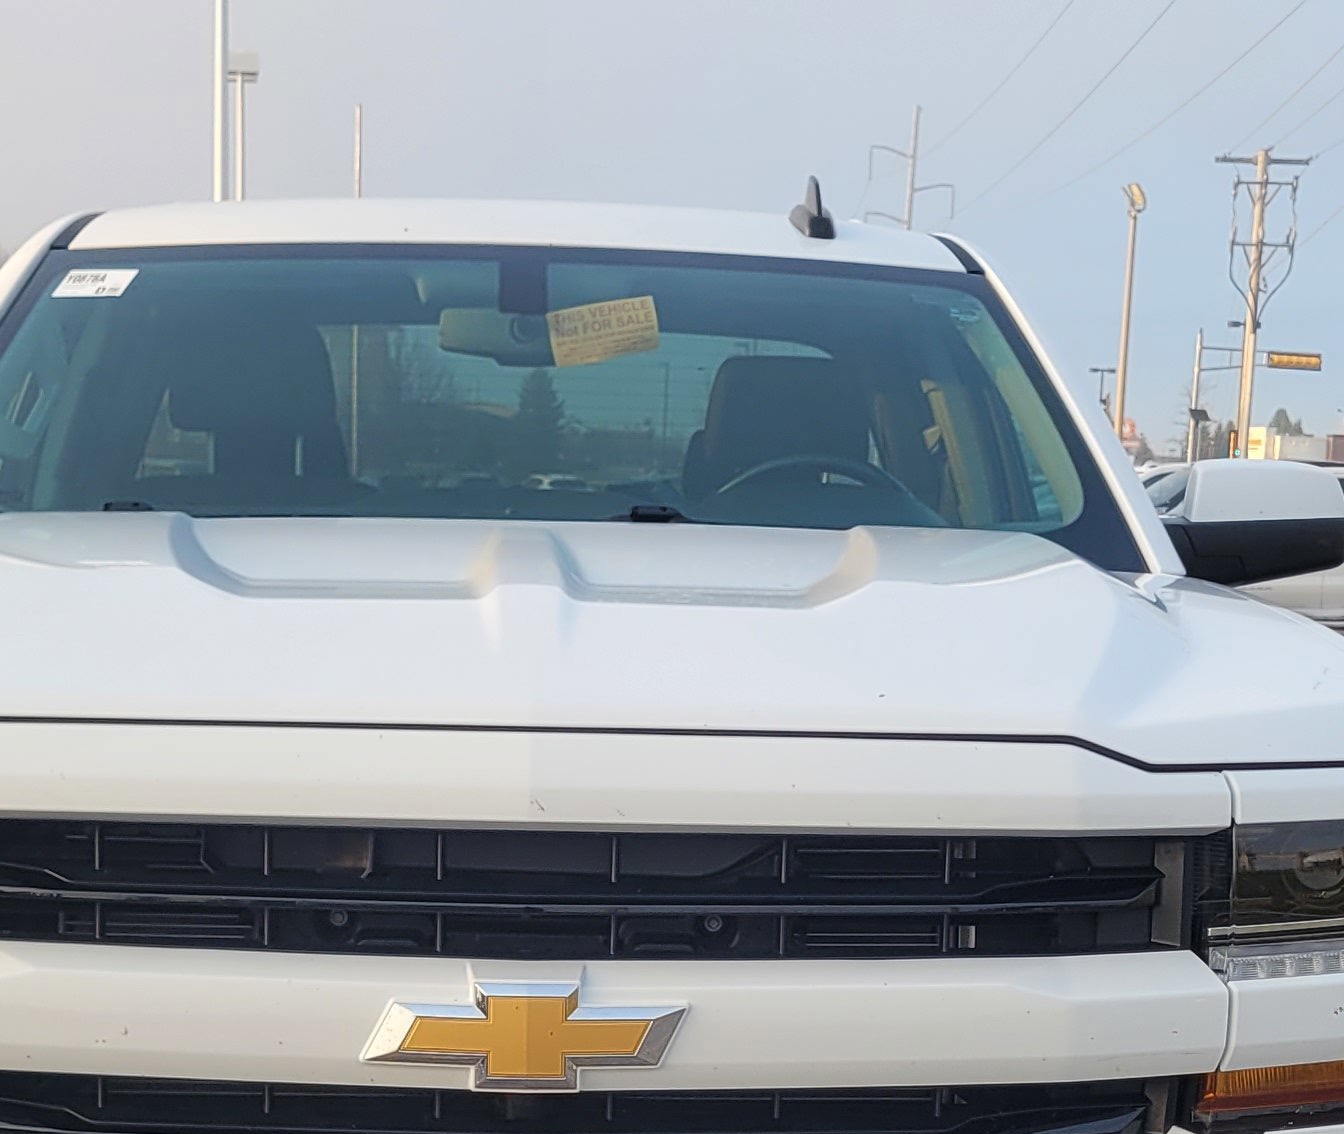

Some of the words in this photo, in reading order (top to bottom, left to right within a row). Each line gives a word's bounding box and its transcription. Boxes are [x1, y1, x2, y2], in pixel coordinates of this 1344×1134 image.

[555, 309, 585, 324] THIS
[588, 300, 649, 318] VEHICLE
[582, 319, 612, 335] FOR
[616, 311, 654, 328] SALE
